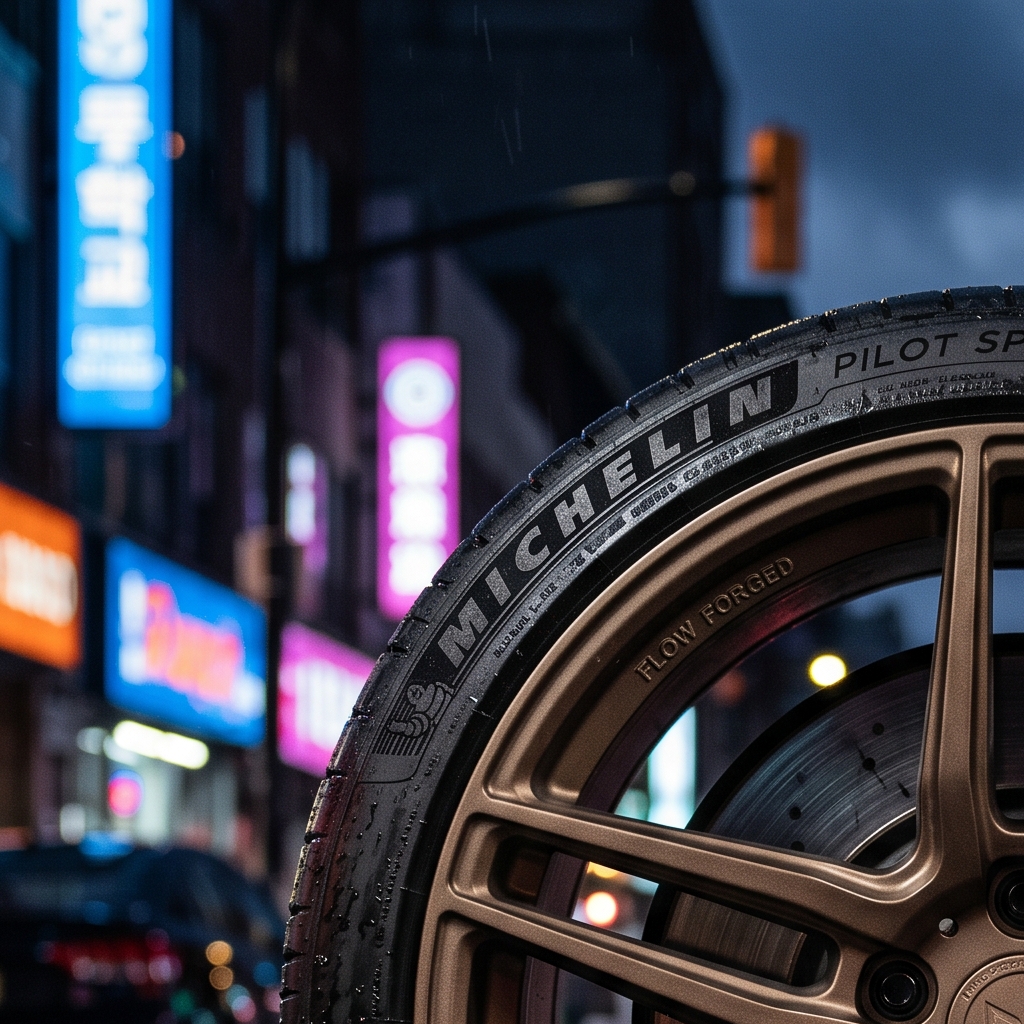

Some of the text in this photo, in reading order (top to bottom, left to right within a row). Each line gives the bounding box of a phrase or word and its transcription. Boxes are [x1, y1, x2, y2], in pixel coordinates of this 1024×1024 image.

[437, 374, 772, 669] MICHELIN
[833, 332, 959, 379] PILOT
[633, 619, 697, 681] FLOW
[699, 556, 795, 626] FORGED
